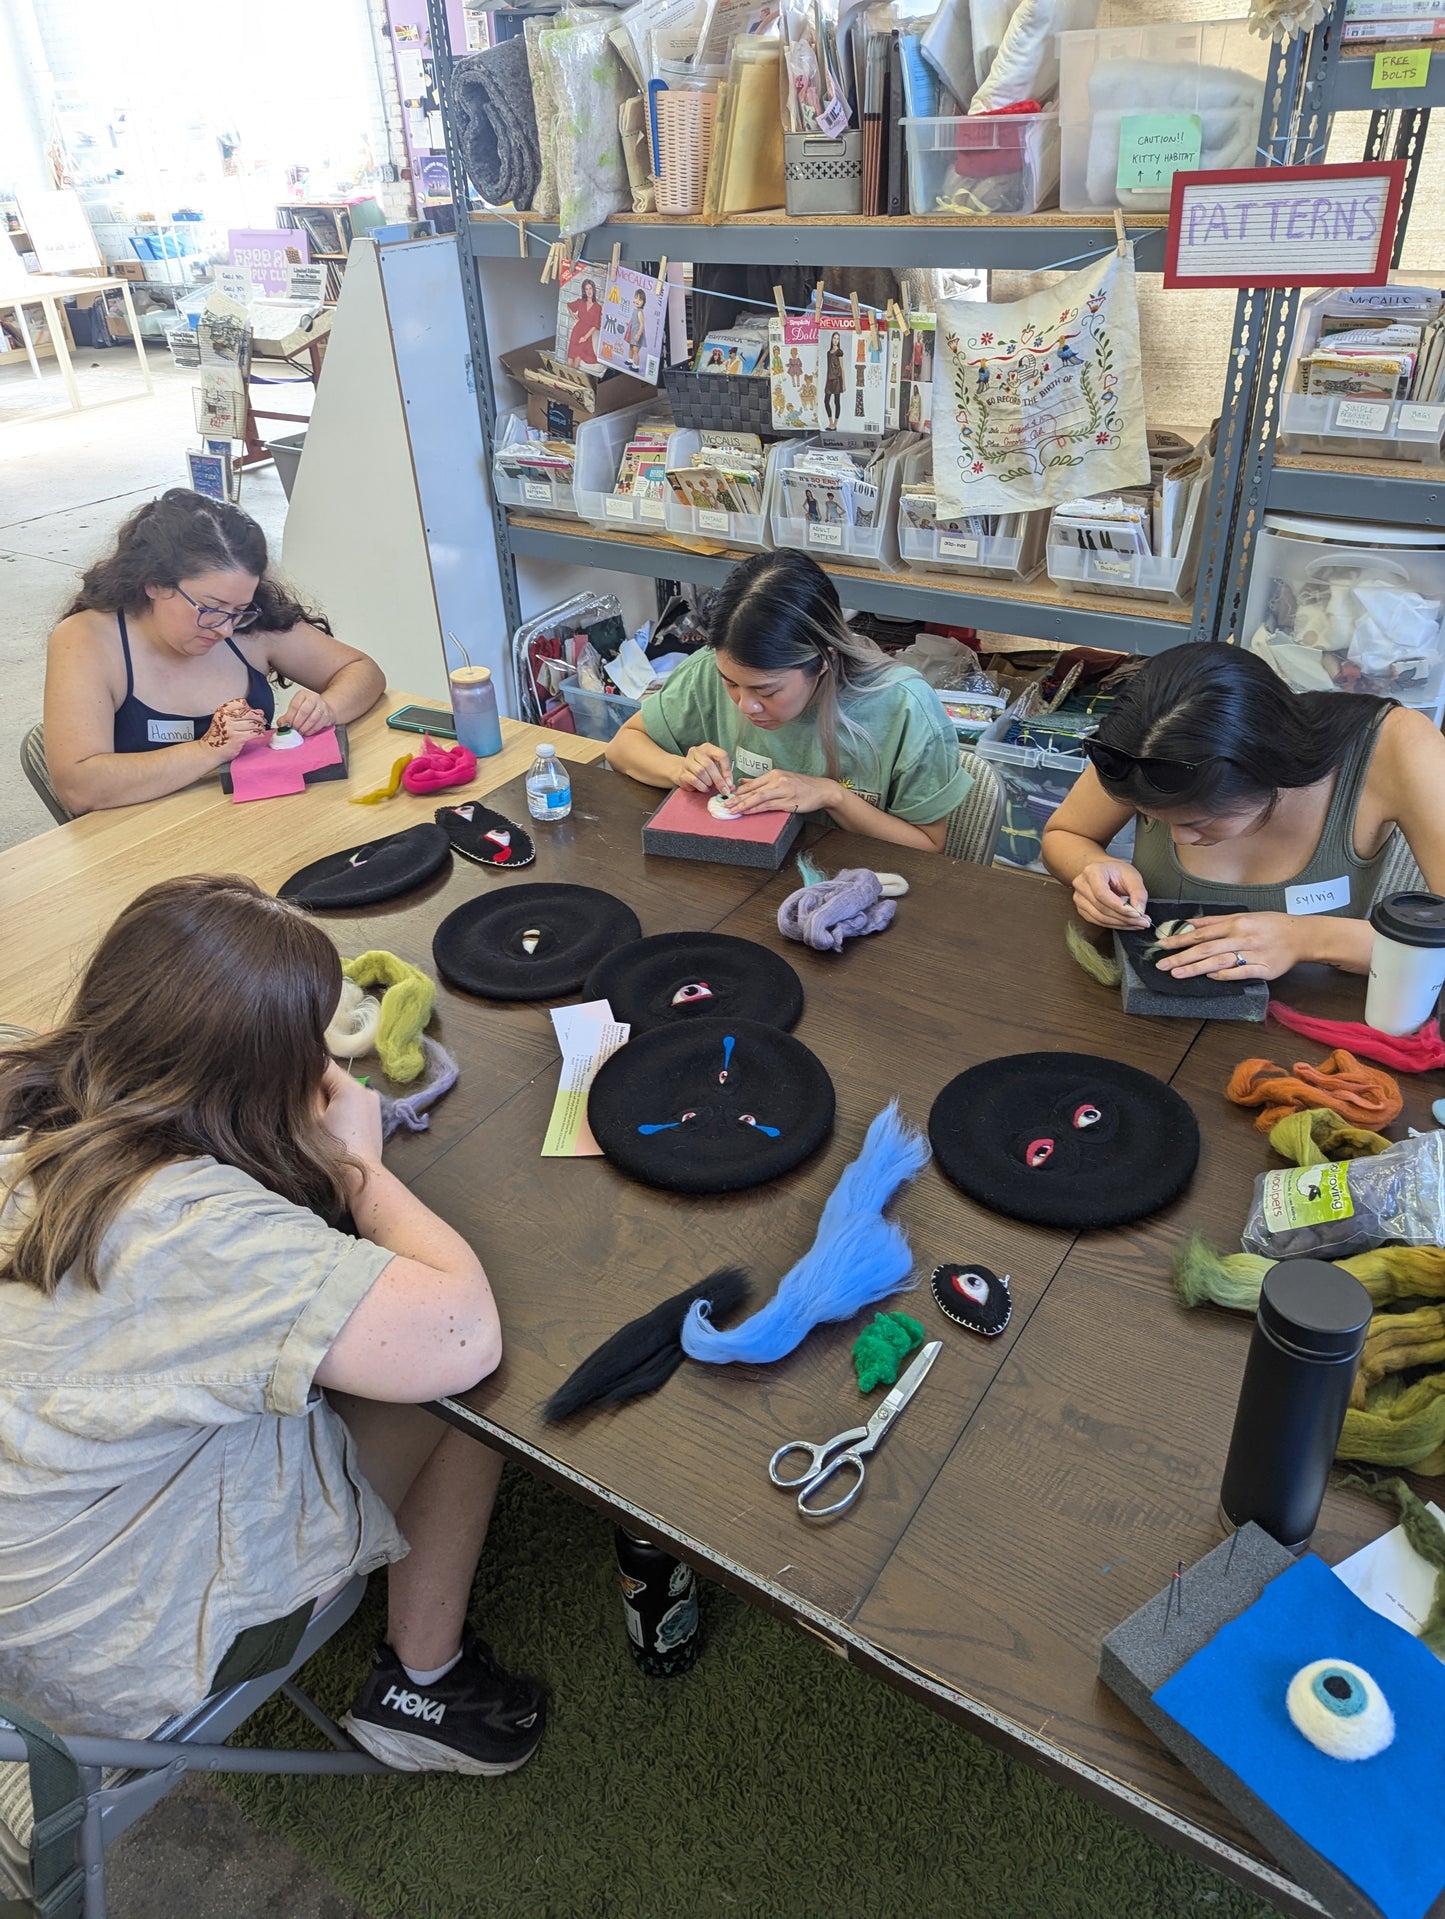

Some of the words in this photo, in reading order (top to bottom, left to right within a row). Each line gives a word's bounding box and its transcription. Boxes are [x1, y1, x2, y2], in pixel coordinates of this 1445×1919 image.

[1382, 56, 1409, 67] FREE
[1381, 68, 1417, 80] BOLTS
[1137, 132, 1184, 145] CAUTION!!
[1132, 154, 1160, 165] KITTY
[1164, 152, 1195, 162] HABITAT
[1188, 197, 1380, 247] PATTERNS
[997, 396, 1021, 405] RECORD
[1022, 395, 1038, 406] THE
[1039, 377, 1061, 398] BIRTH
[1063, 375, 1074, 383] OF
[853, 481, 877, 498] LOOK
[151, 724, 194, 740] Hannah
[738, 754, 770, 771] SILVER
[1295, 890, 1335, 905] sylvia
[1329, 1175, 1343, 1210] roving
[381, 1685, 447, 1725] HOKA
